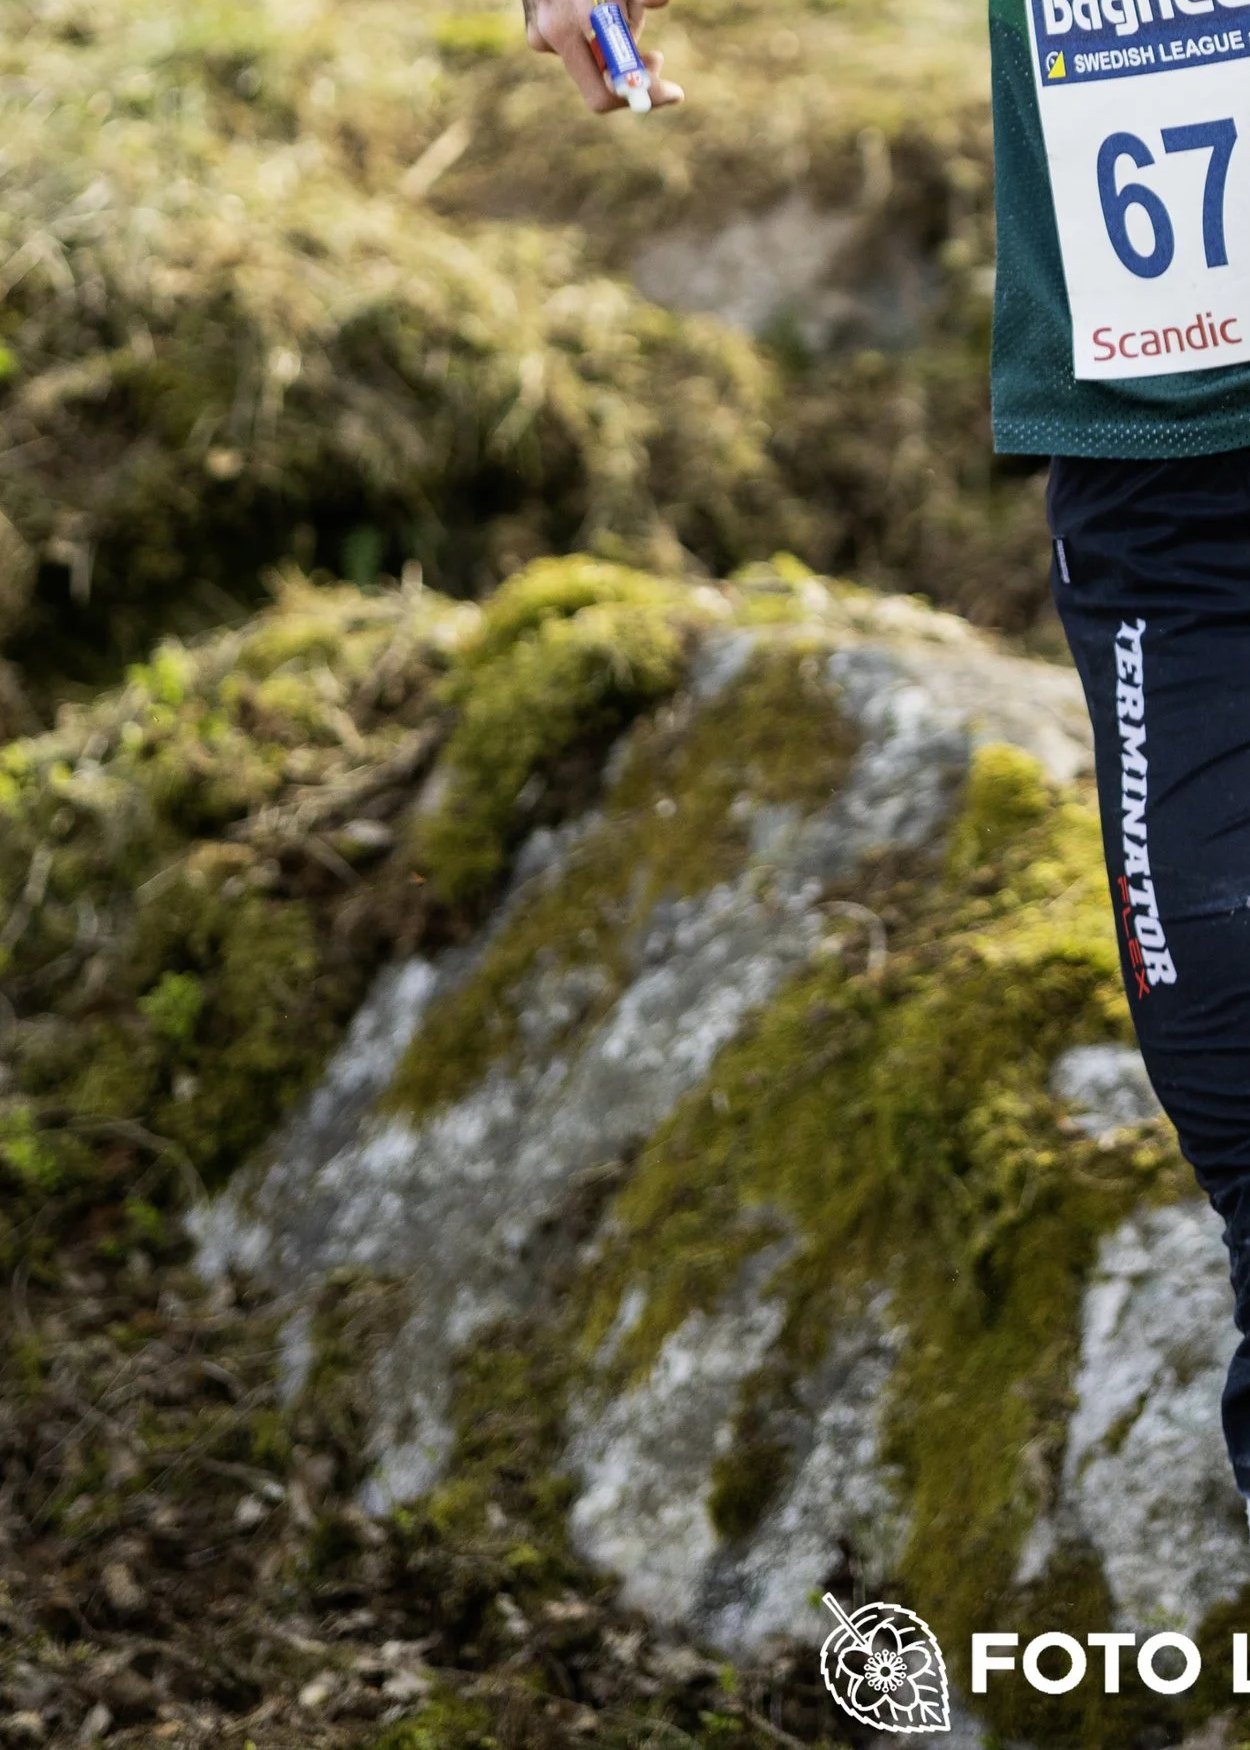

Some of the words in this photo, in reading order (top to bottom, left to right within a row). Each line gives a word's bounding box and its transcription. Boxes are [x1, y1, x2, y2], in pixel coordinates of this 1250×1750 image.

[1073, 48, 1156, 74] SWEDISH
[1158, 30, 1246, 62] LEAGUE
[1092, 312, 1243, 362] Scandic
[1114, 617, 1178, 987] TERMINATOR
[1117, 875, 1151, 1001] FLEX
